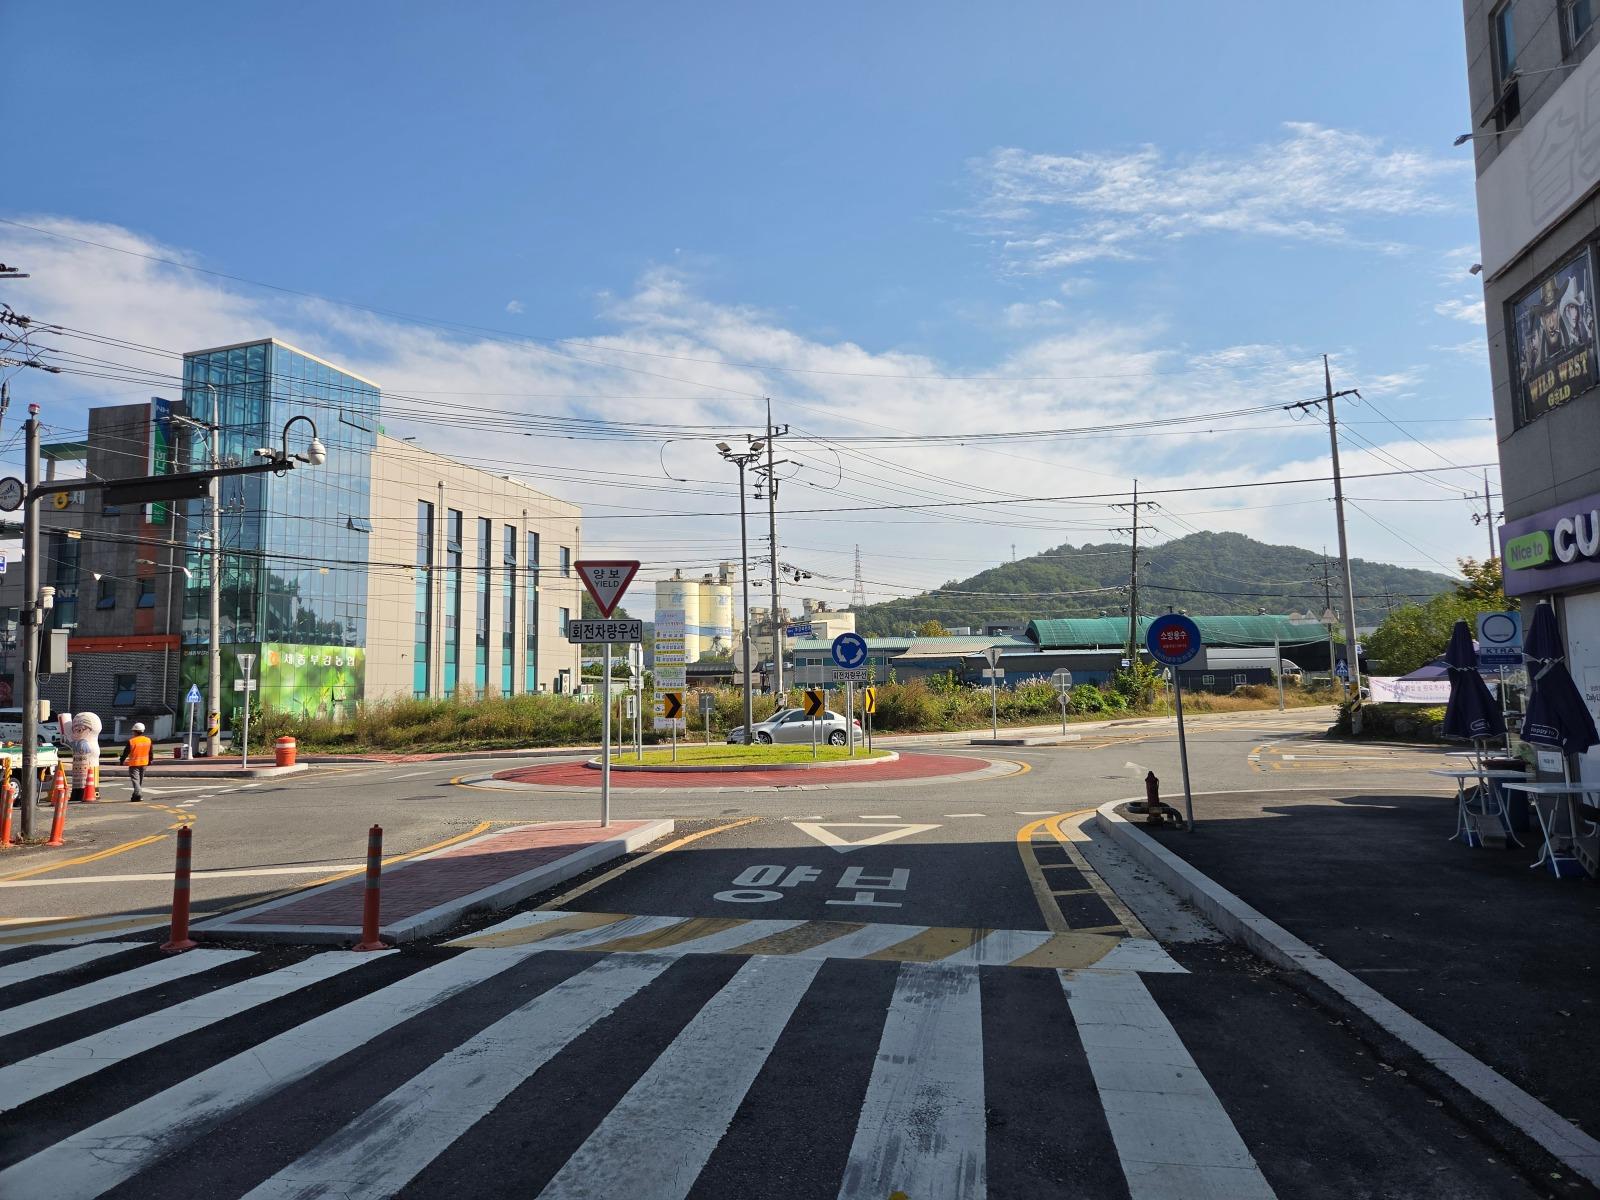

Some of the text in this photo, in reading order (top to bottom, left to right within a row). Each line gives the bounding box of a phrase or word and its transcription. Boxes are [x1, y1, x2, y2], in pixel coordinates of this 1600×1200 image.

[1529, 351, 1588, 402] WILD WEST
[1511, 510, 1600, 563] Nice to CU
[593, 568, 620, 580] 양보
[594, 580, 620, 588] YIELD
[572, 623, 639, 640] 회전차량우선
[1160, 630, 1188, 641] 소방용수
[834, 670, 867, 680] 회전차량우선
[713, 865, 911, 908] 양보
